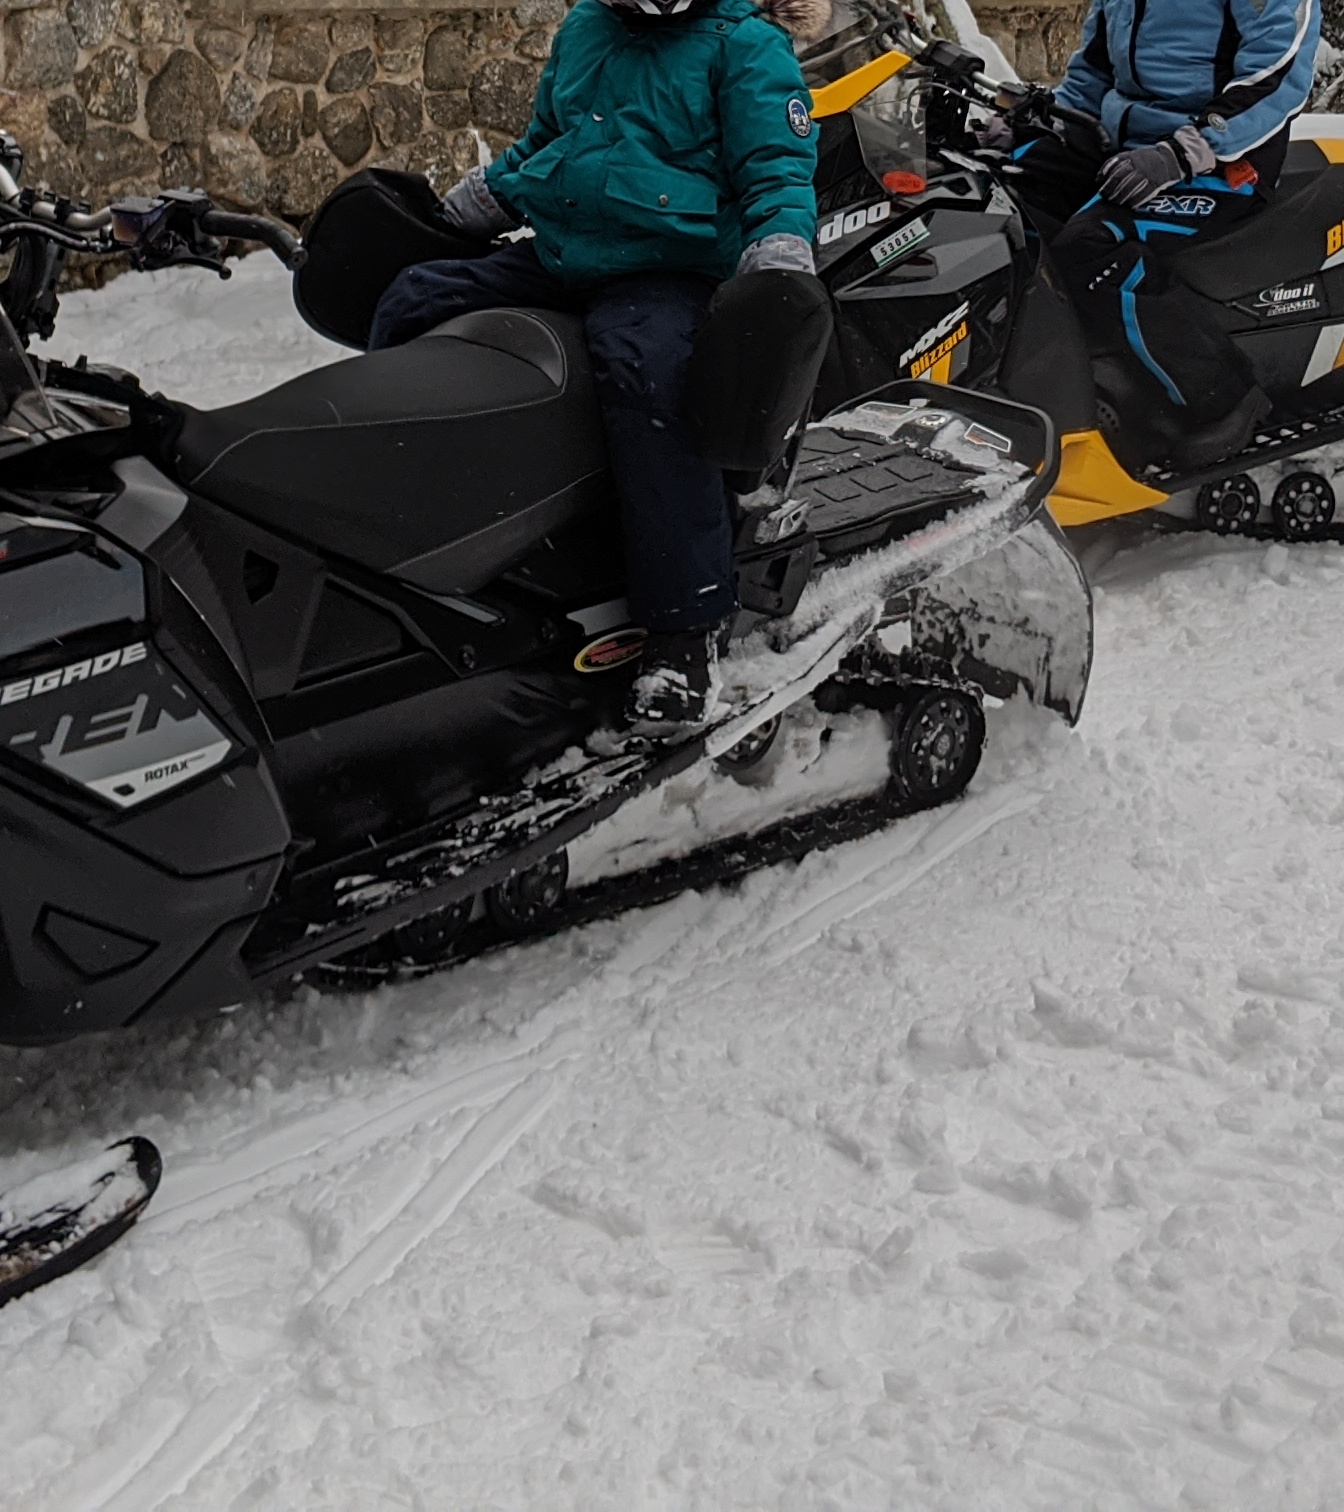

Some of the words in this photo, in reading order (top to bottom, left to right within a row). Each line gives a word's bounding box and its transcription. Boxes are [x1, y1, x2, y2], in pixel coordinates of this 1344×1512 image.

[1138, 196, 1216, 215] FXR
[817, 201, 891, 245] doo
[880, 228, 917, 257] 53051
[910, 320, 967, 380] Blizzard
[145, 759, 188, 783] ROTAX
